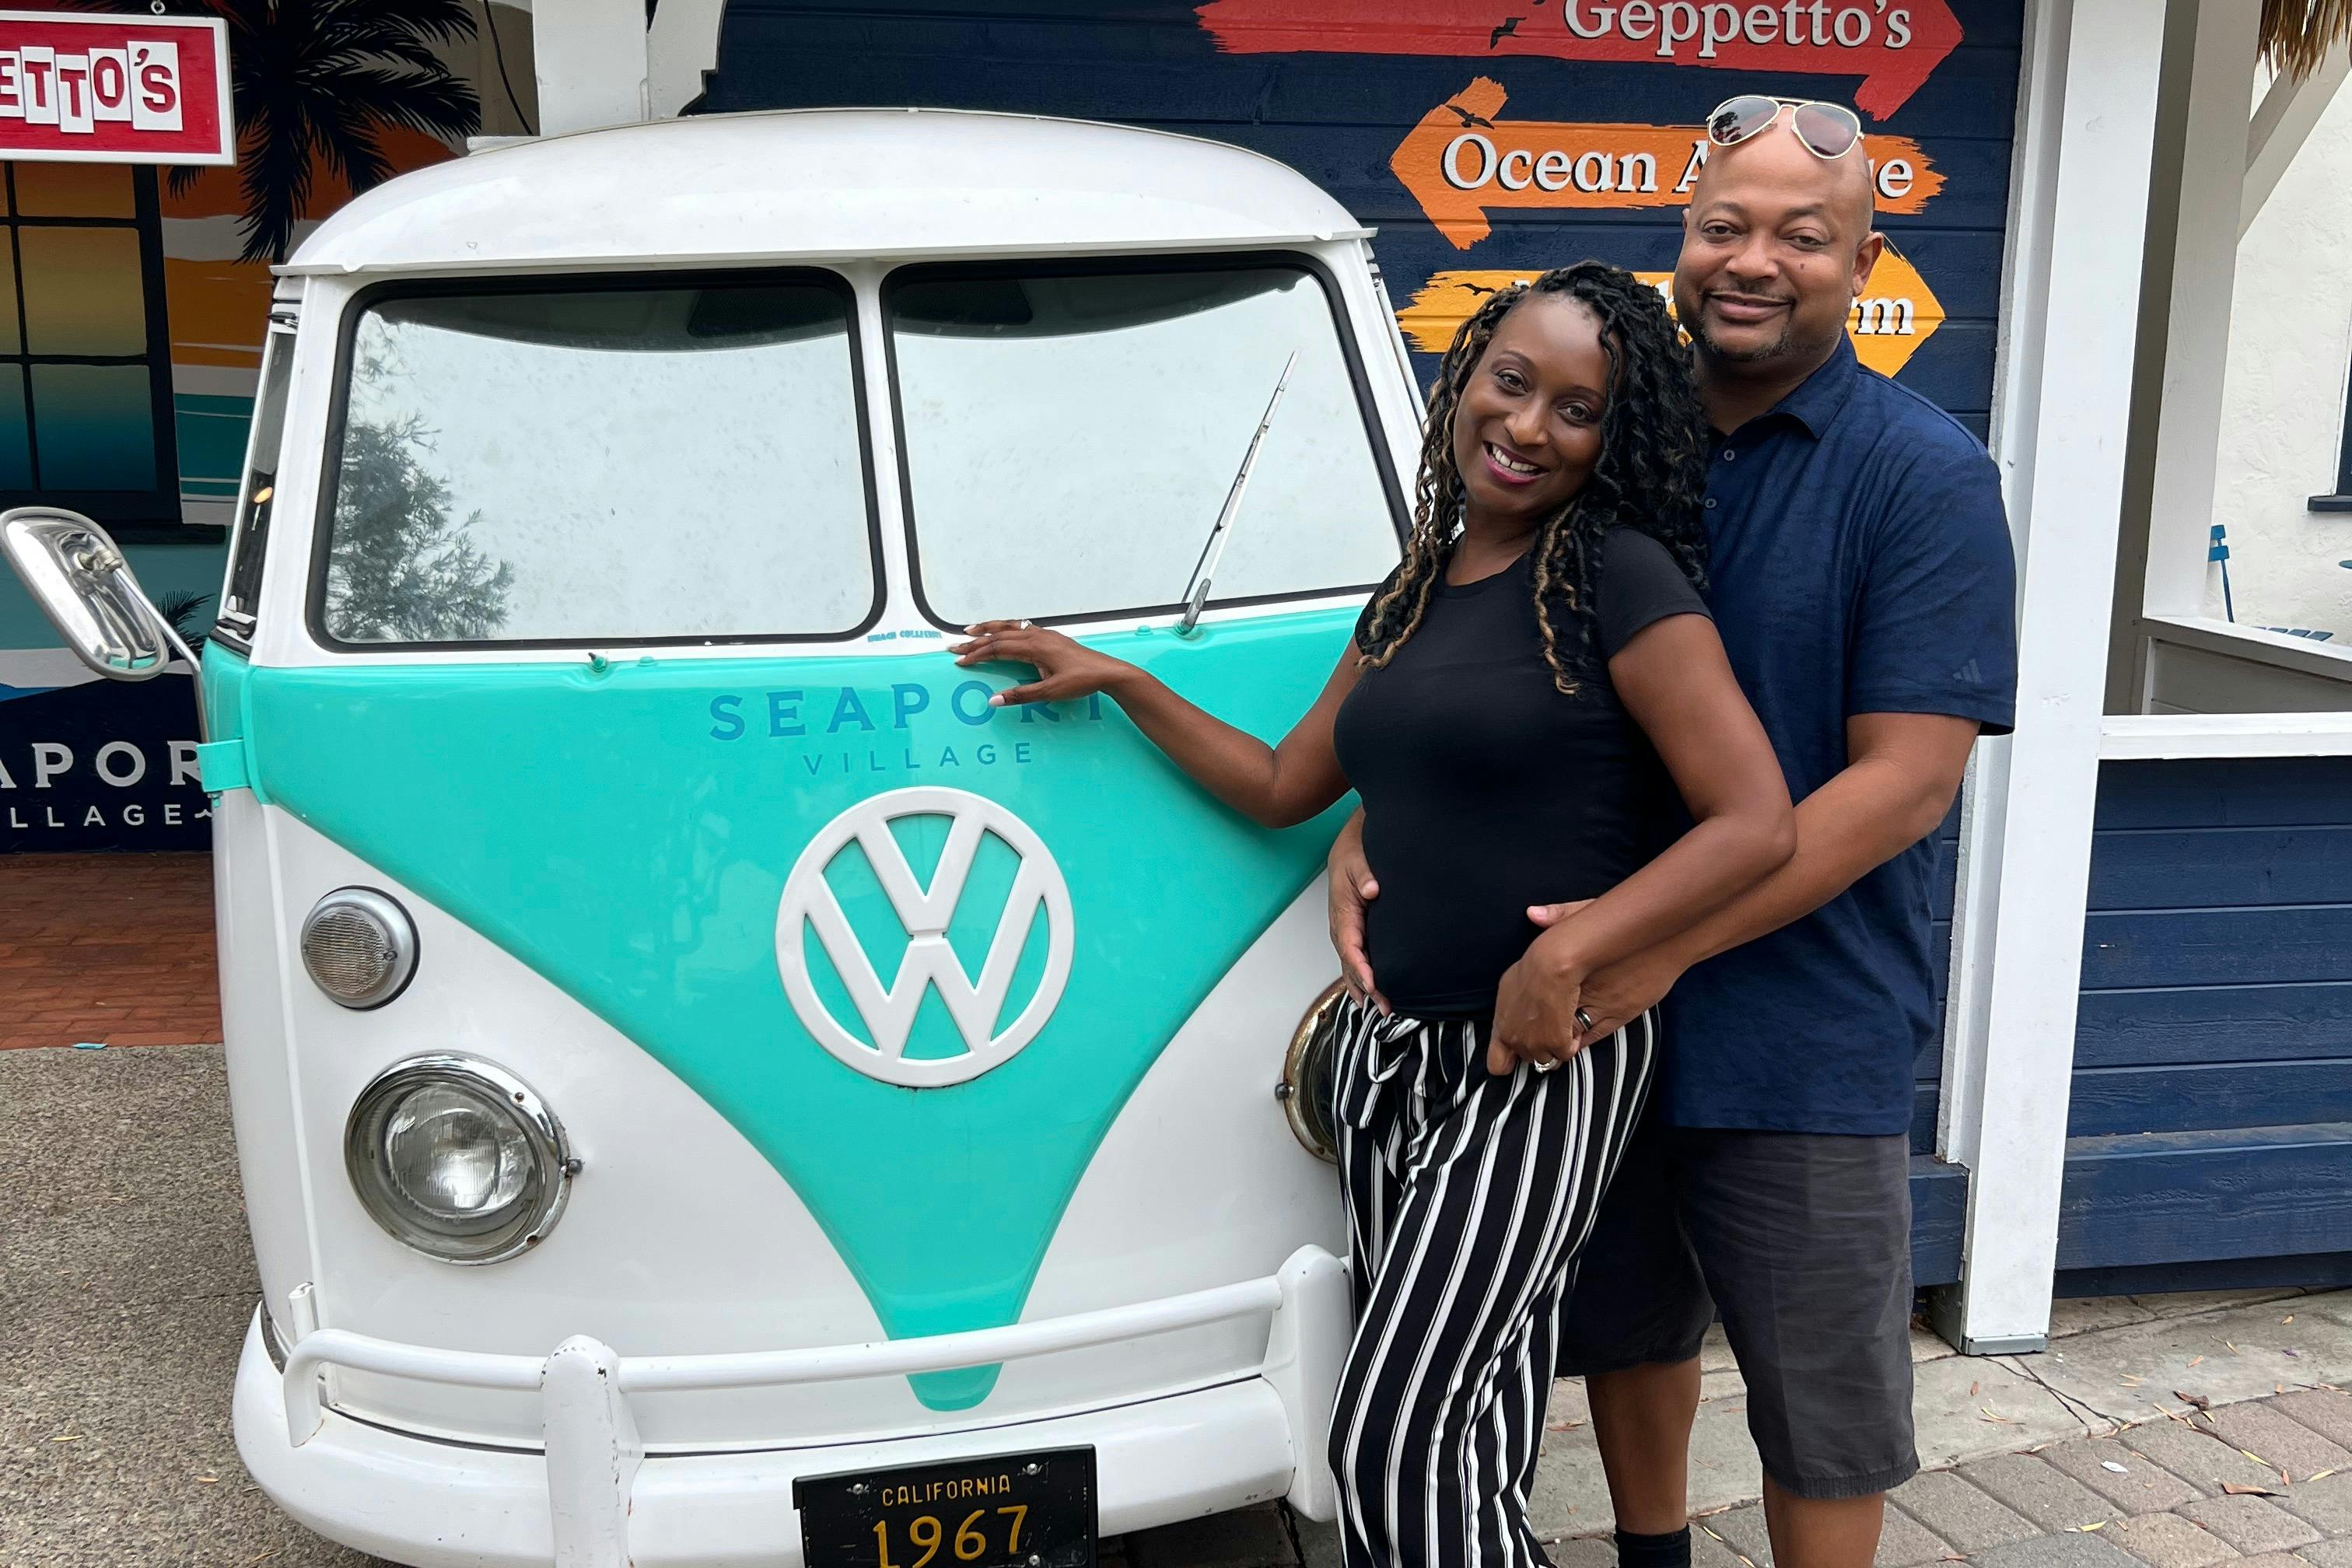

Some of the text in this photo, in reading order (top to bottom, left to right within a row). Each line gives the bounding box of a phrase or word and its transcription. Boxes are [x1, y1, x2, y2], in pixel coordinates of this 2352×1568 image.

[1563, 0, 1913, 58] Geppetto's
[1441, 133, 1659, 192] Ocean
[803, 742, 1031, 775] VILLAGE
[882, 1475, 1011, 1507] CALIFORNIA
[872, 1505, 1029, 1568] 1967
